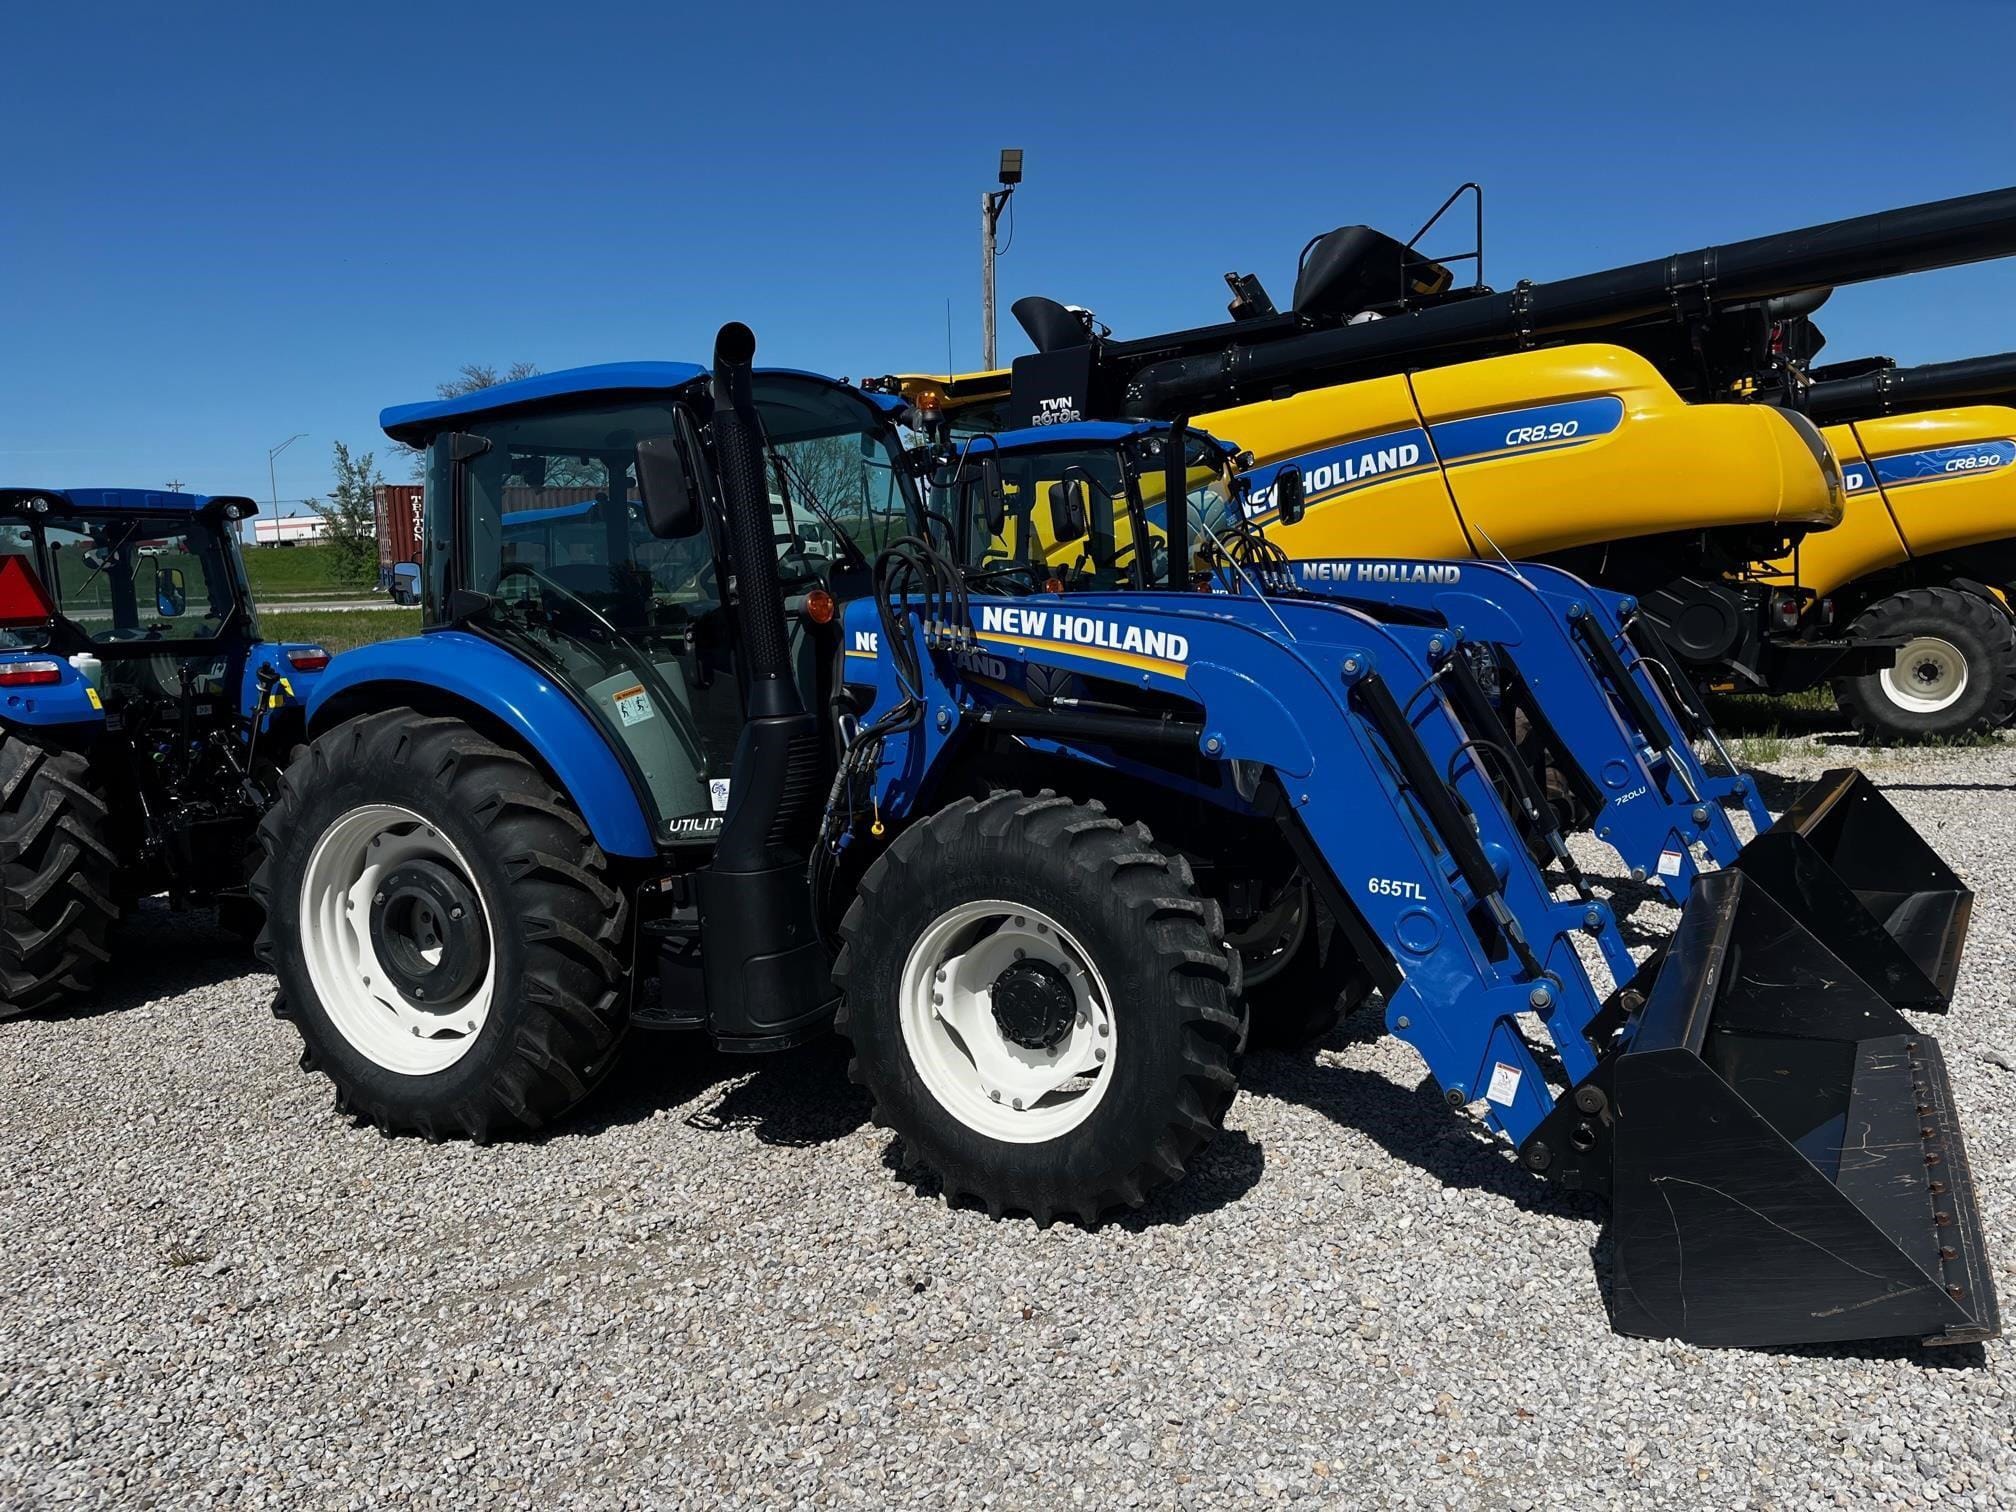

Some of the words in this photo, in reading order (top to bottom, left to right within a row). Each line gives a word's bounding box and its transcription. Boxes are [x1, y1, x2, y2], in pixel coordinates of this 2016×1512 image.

[1040, 396, 1072, 411] TWIN
[1032, 409, 1081, 426] ROTOR
[1506, 420, 1579, 445] CR8.90
[1303, 443, 1419, 494] HOLLAND
[1945, 455, 2001, 472] CR8.90
[411, 495, 424, 541] TRITON
[1302, 563, 1352, 582] NEW
[1357, 564, 1461, 585] HOLLAND
[856, 631, 878, 652] NE
[982, 606, 1047, 637] NEW
[1053, 614, 1189, 662] HOLLAND
[1615, 786, 1646, 806] 720LU
[1368, 877, 1427, 900] 655TL
